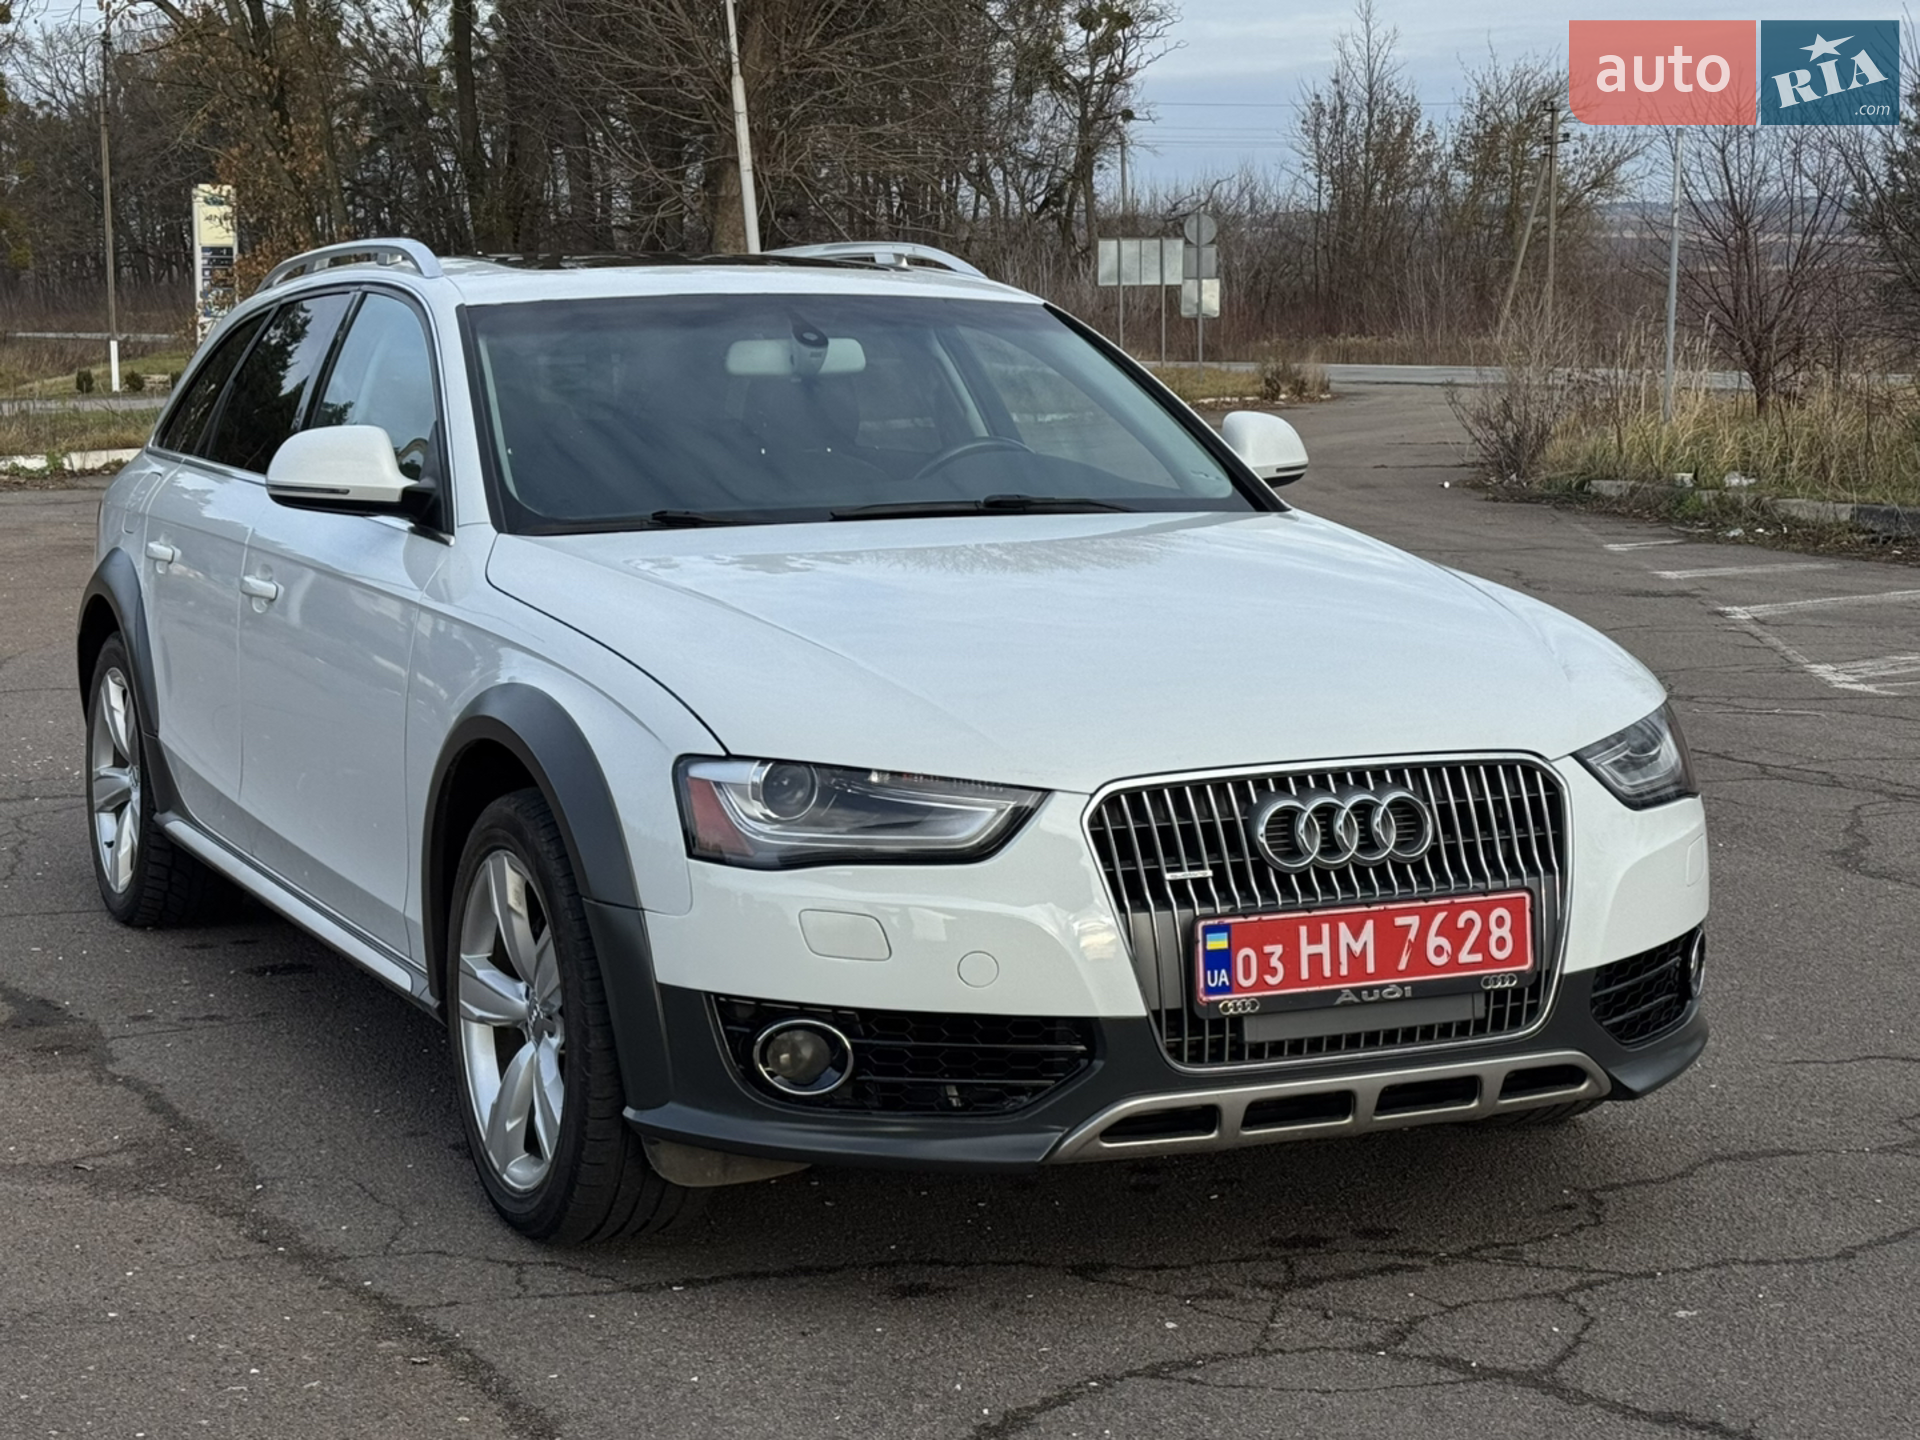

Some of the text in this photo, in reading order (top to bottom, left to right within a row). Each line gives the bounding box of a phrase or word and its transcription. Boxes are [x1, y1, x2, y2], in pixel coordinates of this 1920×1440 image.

[1235, 907, 1514, 988] 03 HM 7628
[1207, 969, 1230, 987] UA
